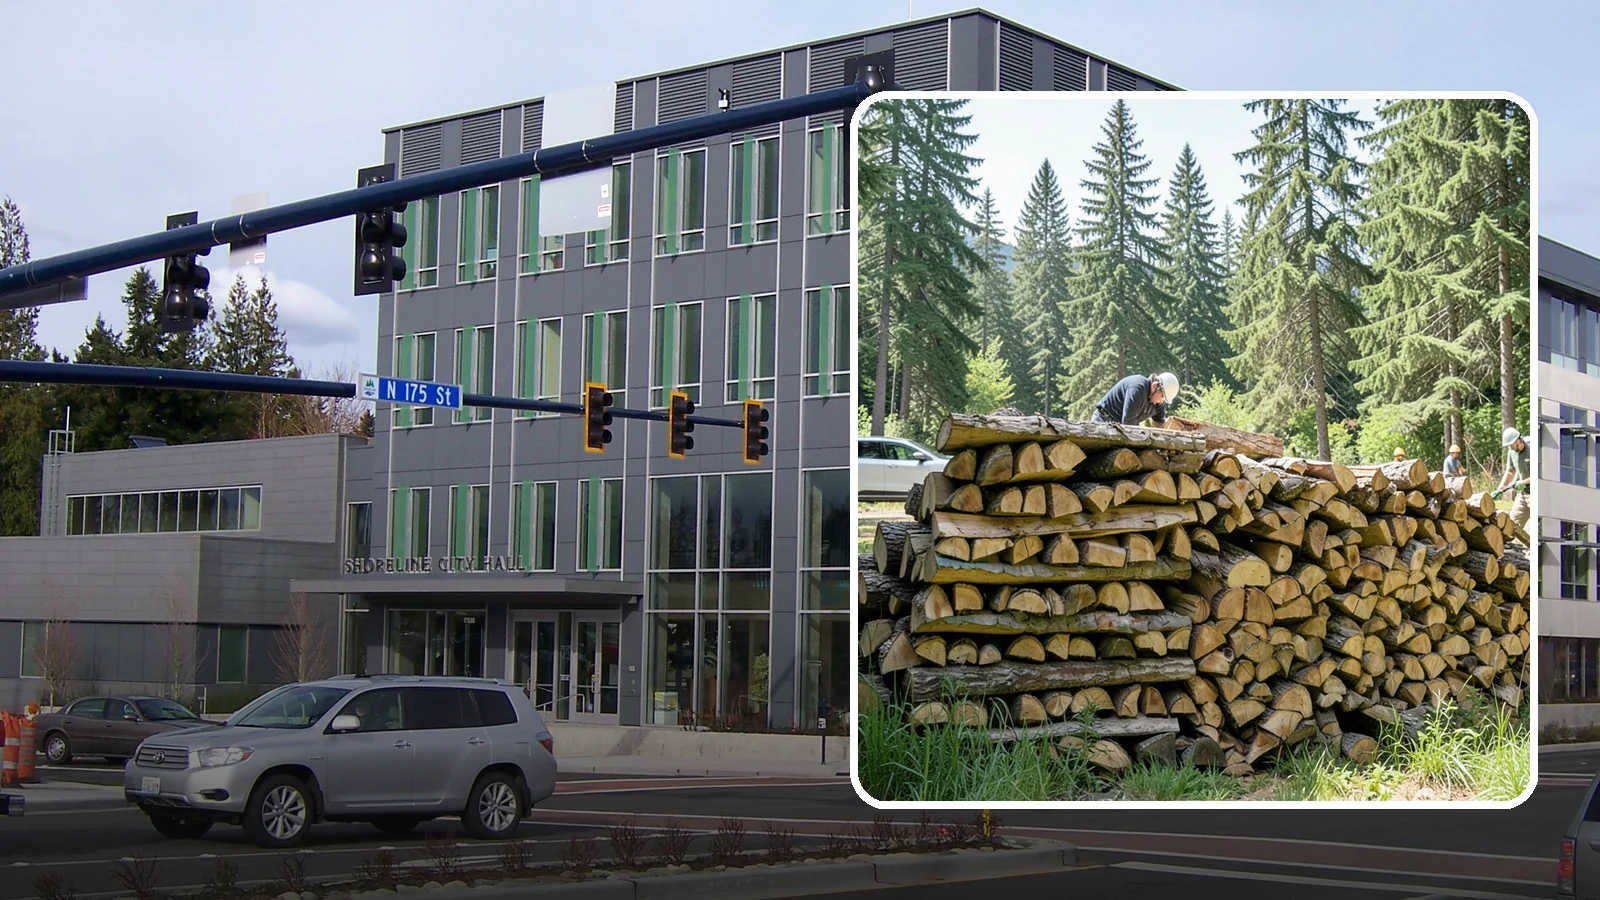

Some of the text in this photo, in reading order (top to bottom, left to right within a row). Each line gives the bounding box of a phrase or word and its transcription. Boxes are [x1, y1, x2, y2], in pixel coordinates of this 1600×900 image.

[387, 381, 451, 406] N 175 St
[343, 555, 525, 574] SHORELINE CITY HALL
